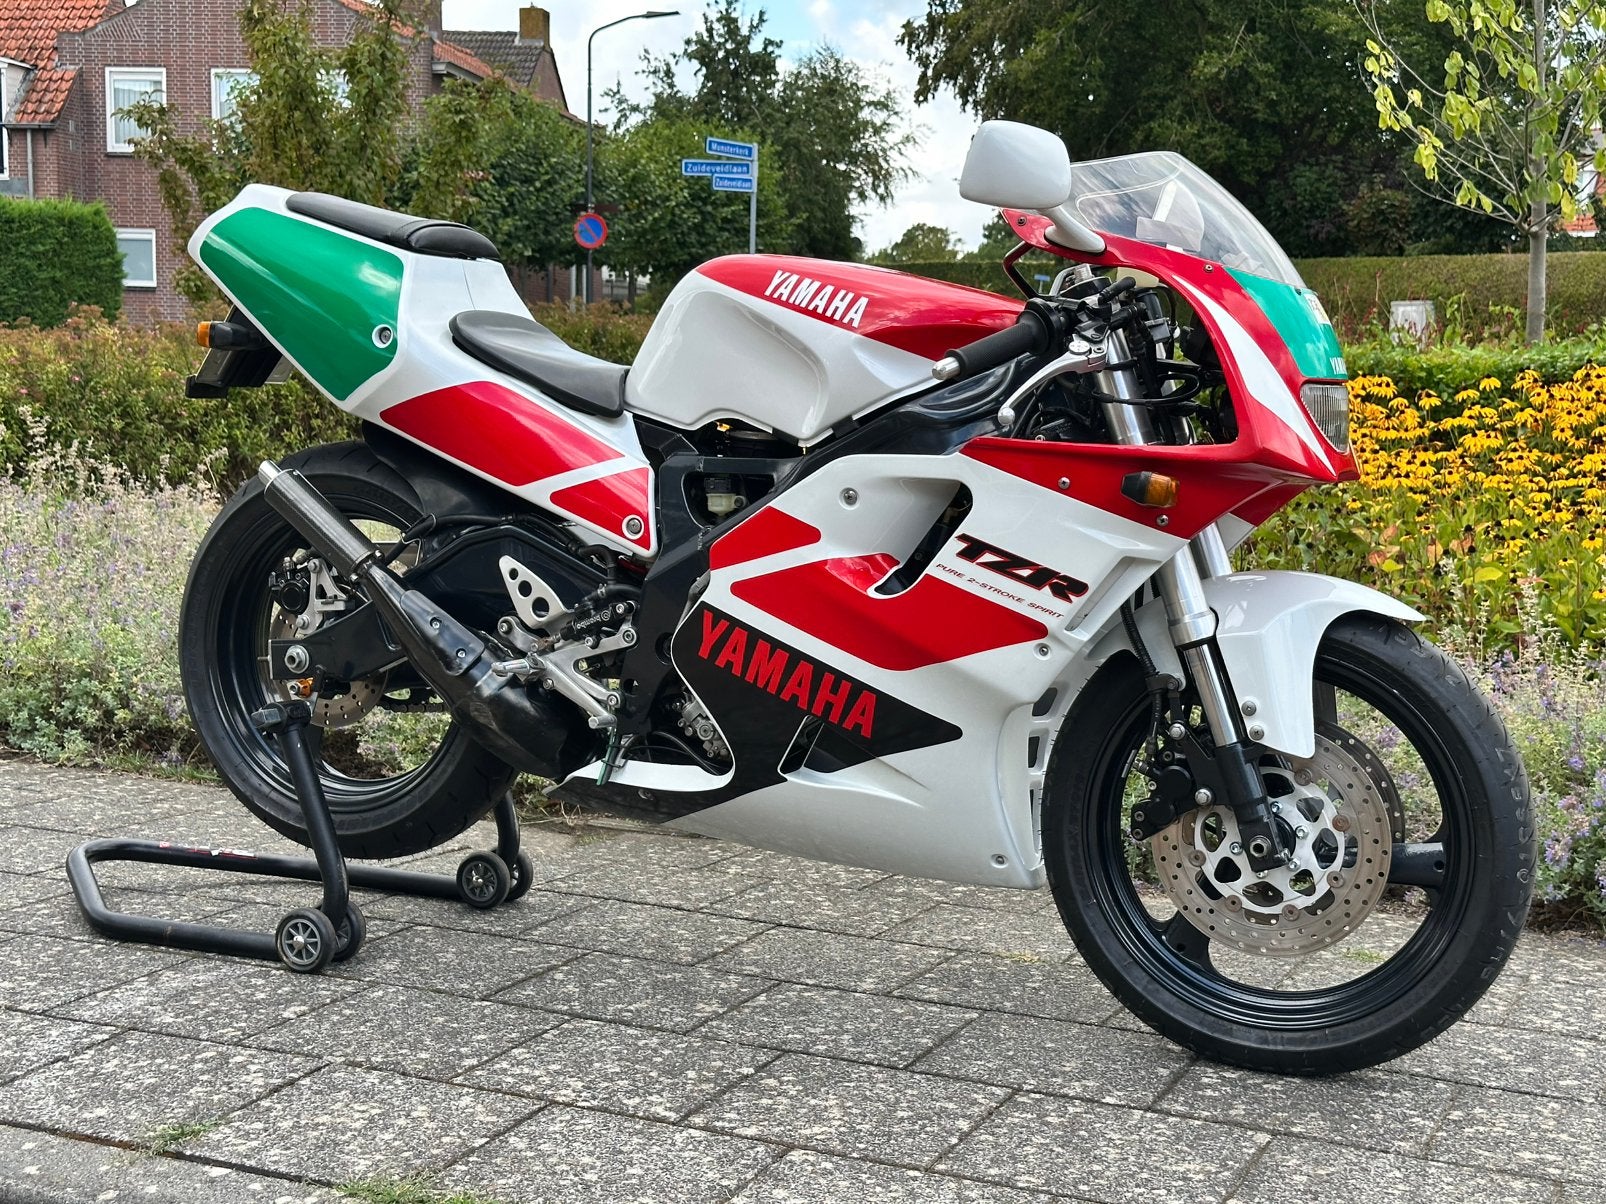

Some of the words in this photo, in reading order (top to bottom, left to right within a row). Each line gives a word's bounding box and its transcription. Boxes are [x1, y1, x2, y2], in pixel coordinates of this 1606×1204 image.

[764, 269, 869, 329] YAMAHA
[935, 563, 964, 579] PURE
[967, 577, 1025, 604] 2-STROKE
[1027, 602, 1065, 619] SPIRIT
[954, 533, 1090, 604] TZR
[698, 609, 877, 739] YAMAHA
